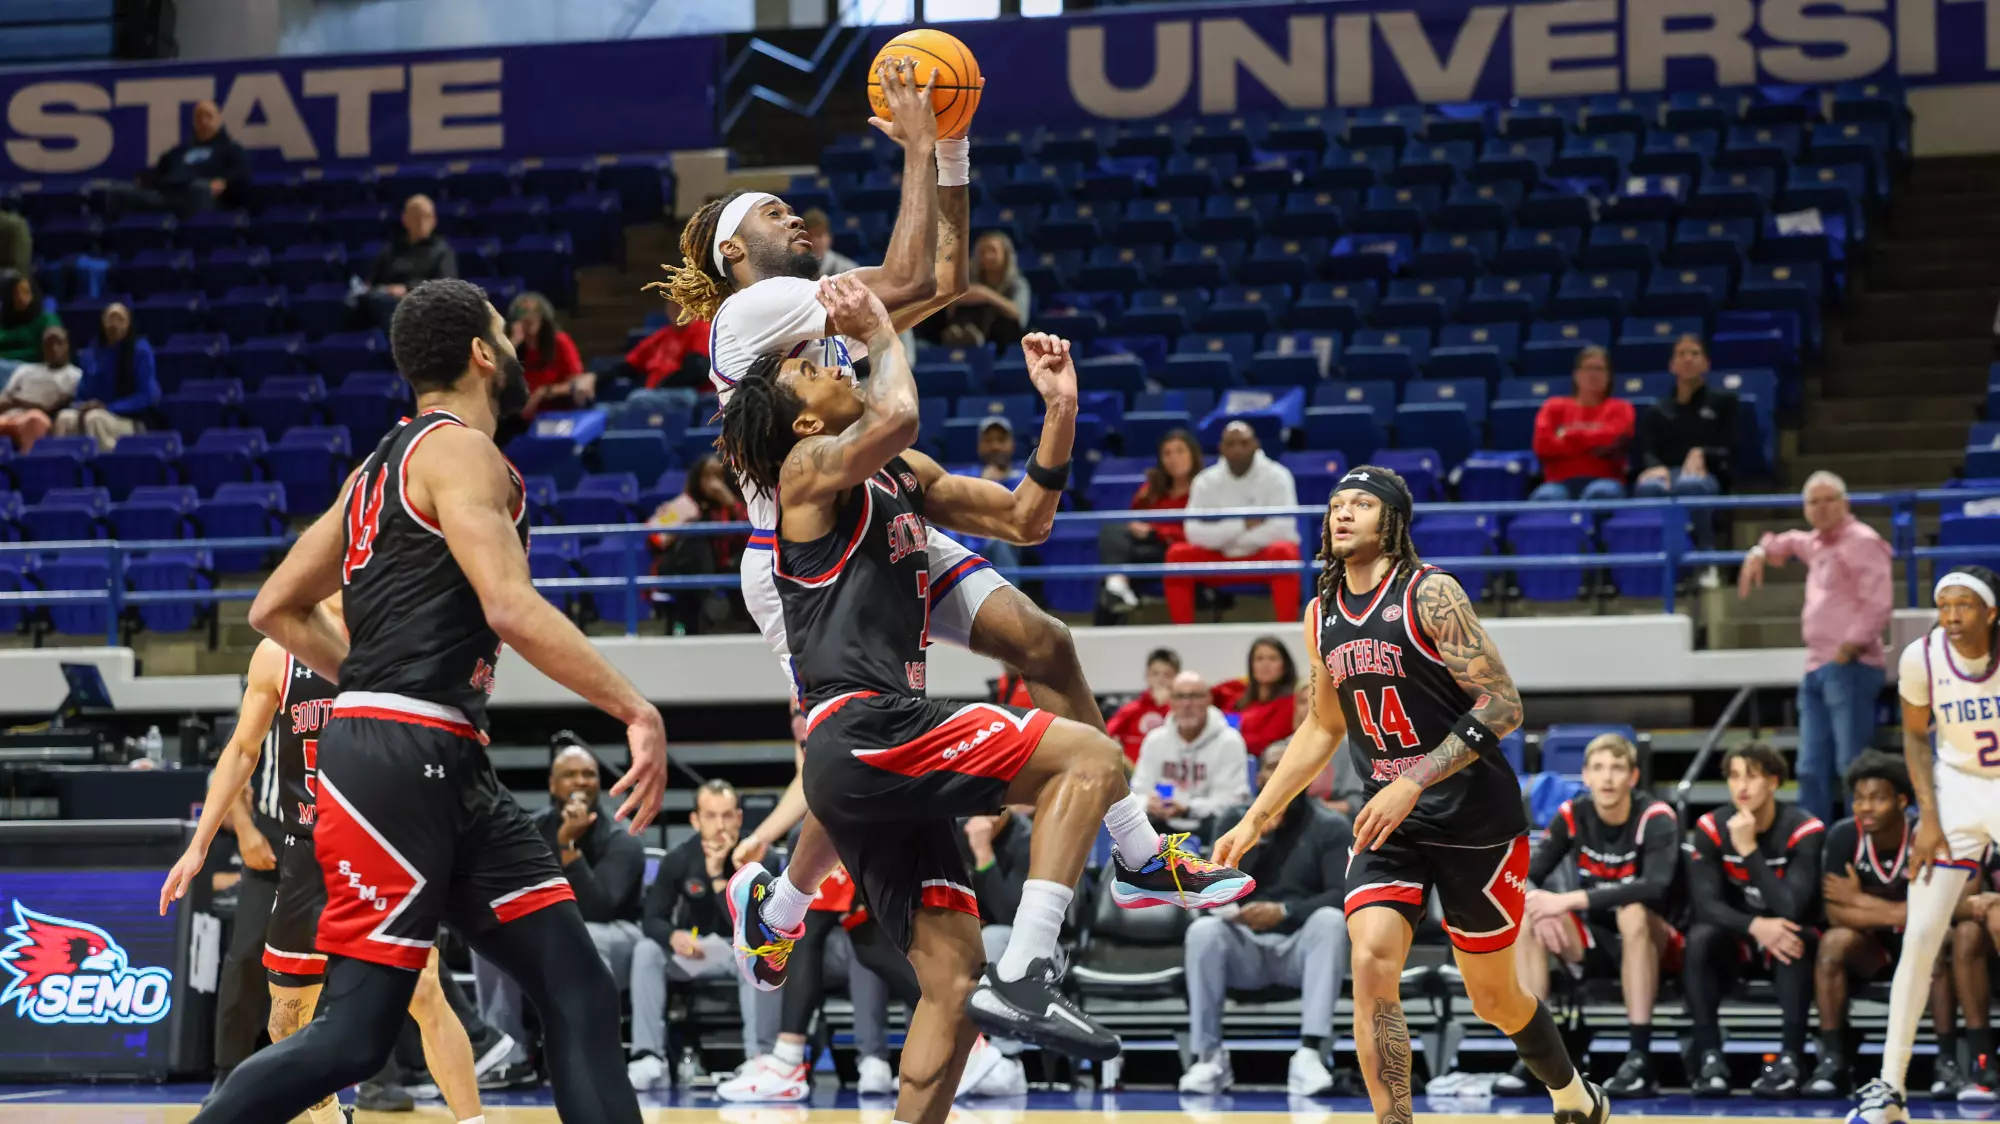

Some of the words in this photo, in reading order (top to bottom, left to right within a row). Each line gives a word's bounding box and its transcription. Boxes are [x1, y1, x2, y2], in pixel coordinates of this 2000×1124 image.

[4, 57, 505, 174] STATE
[1326, 638, 1407, 689] SOUTHEAST
[291, 697, 337, 735] SOUT
[942, 721, 1006, 760] SEMO
[1353, 684, 1421, 752] 44
[338, 860, 388, 911] SEMO
[35, 973, 168, 1017] SEMO
